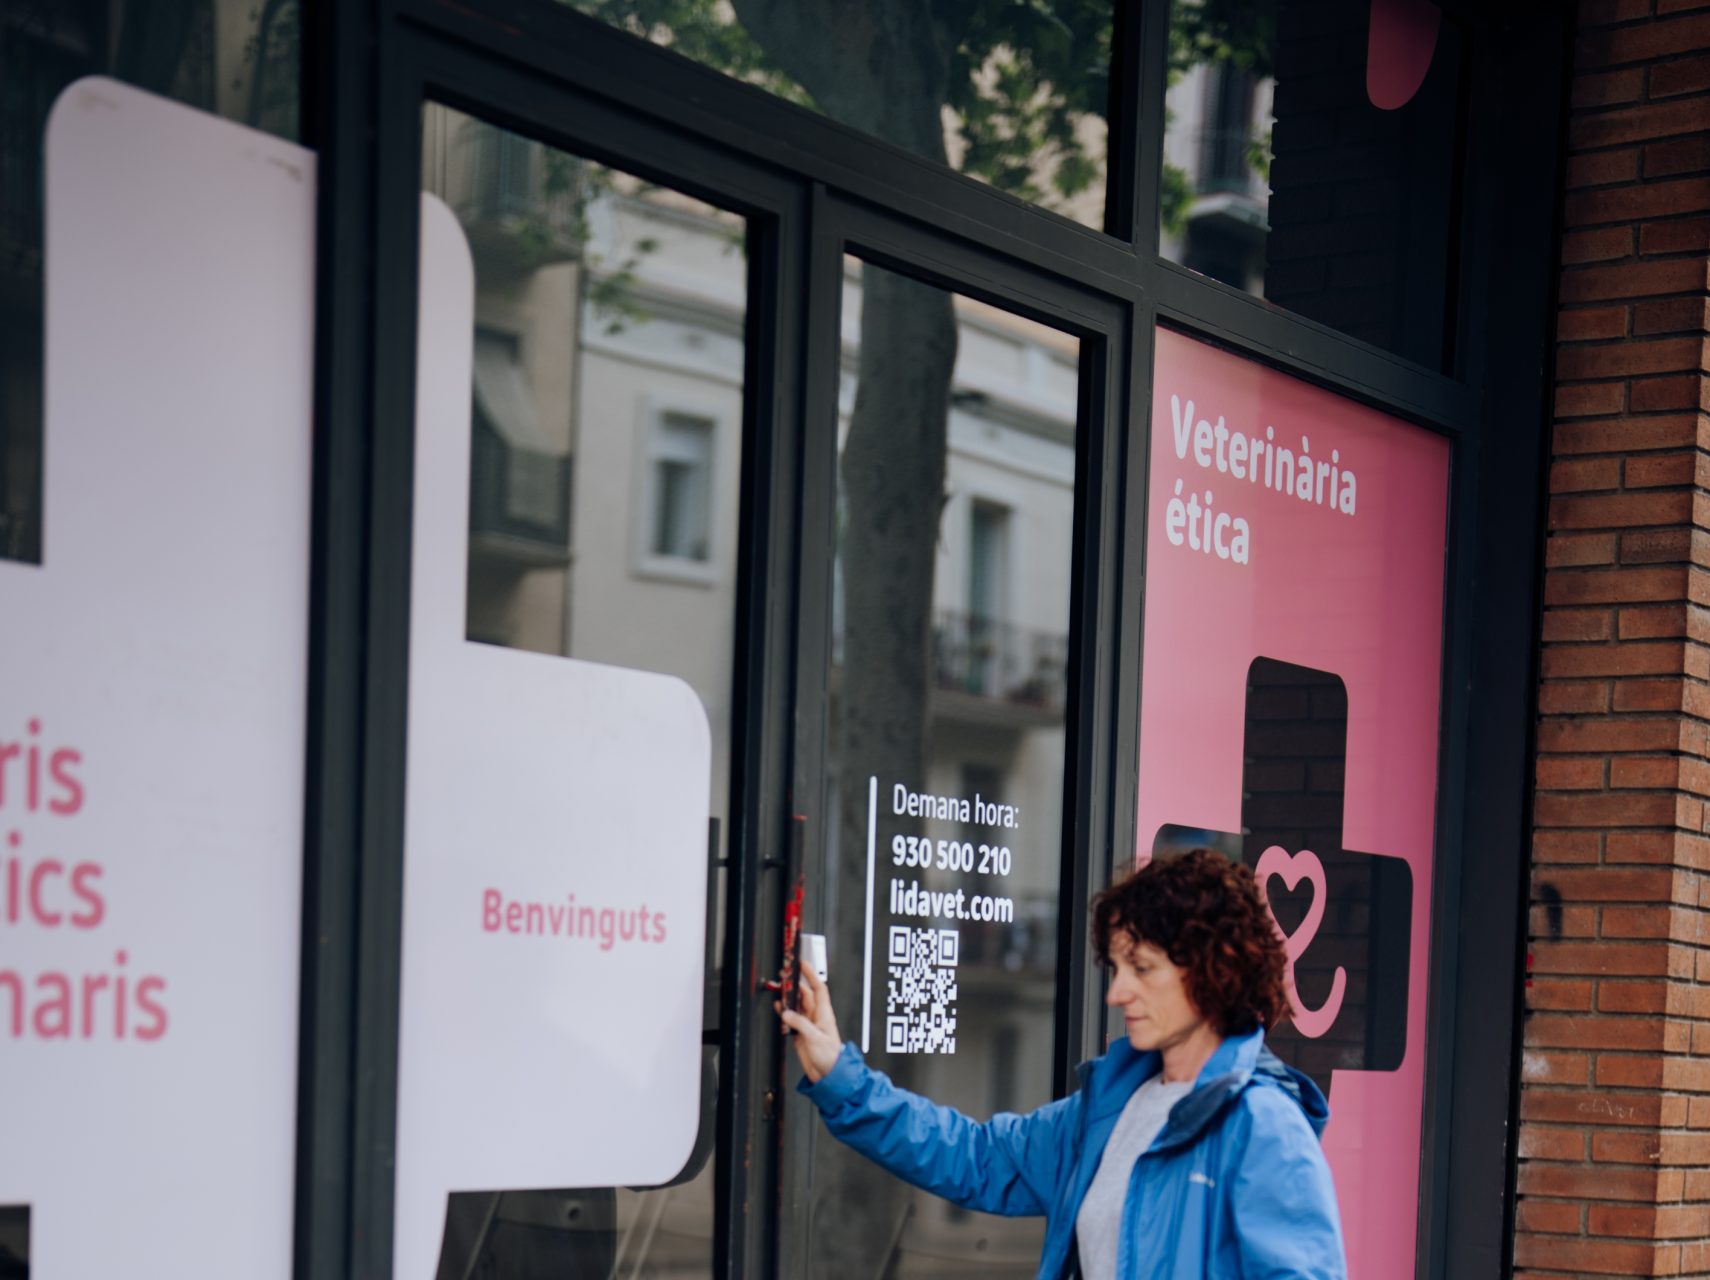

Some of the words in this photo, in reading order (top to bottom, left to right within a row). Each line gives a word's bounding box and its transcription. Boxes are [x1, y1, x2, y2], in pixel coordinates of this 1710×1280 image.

[1171, 394, 1356, 516] Veterinària
[1166, 478, 1249, 565] ética
[893, 783, 970, 823] Demana
[975, 793, 1019, 829] hora:
[892, 835, 932, 868] 930
[936, 840, 974, 872] 500
[978, 844, 1011, 876] 210
[483, 887, 666, 951] Benvinguts
[890, 878, 1013, 923] lidavet.com
